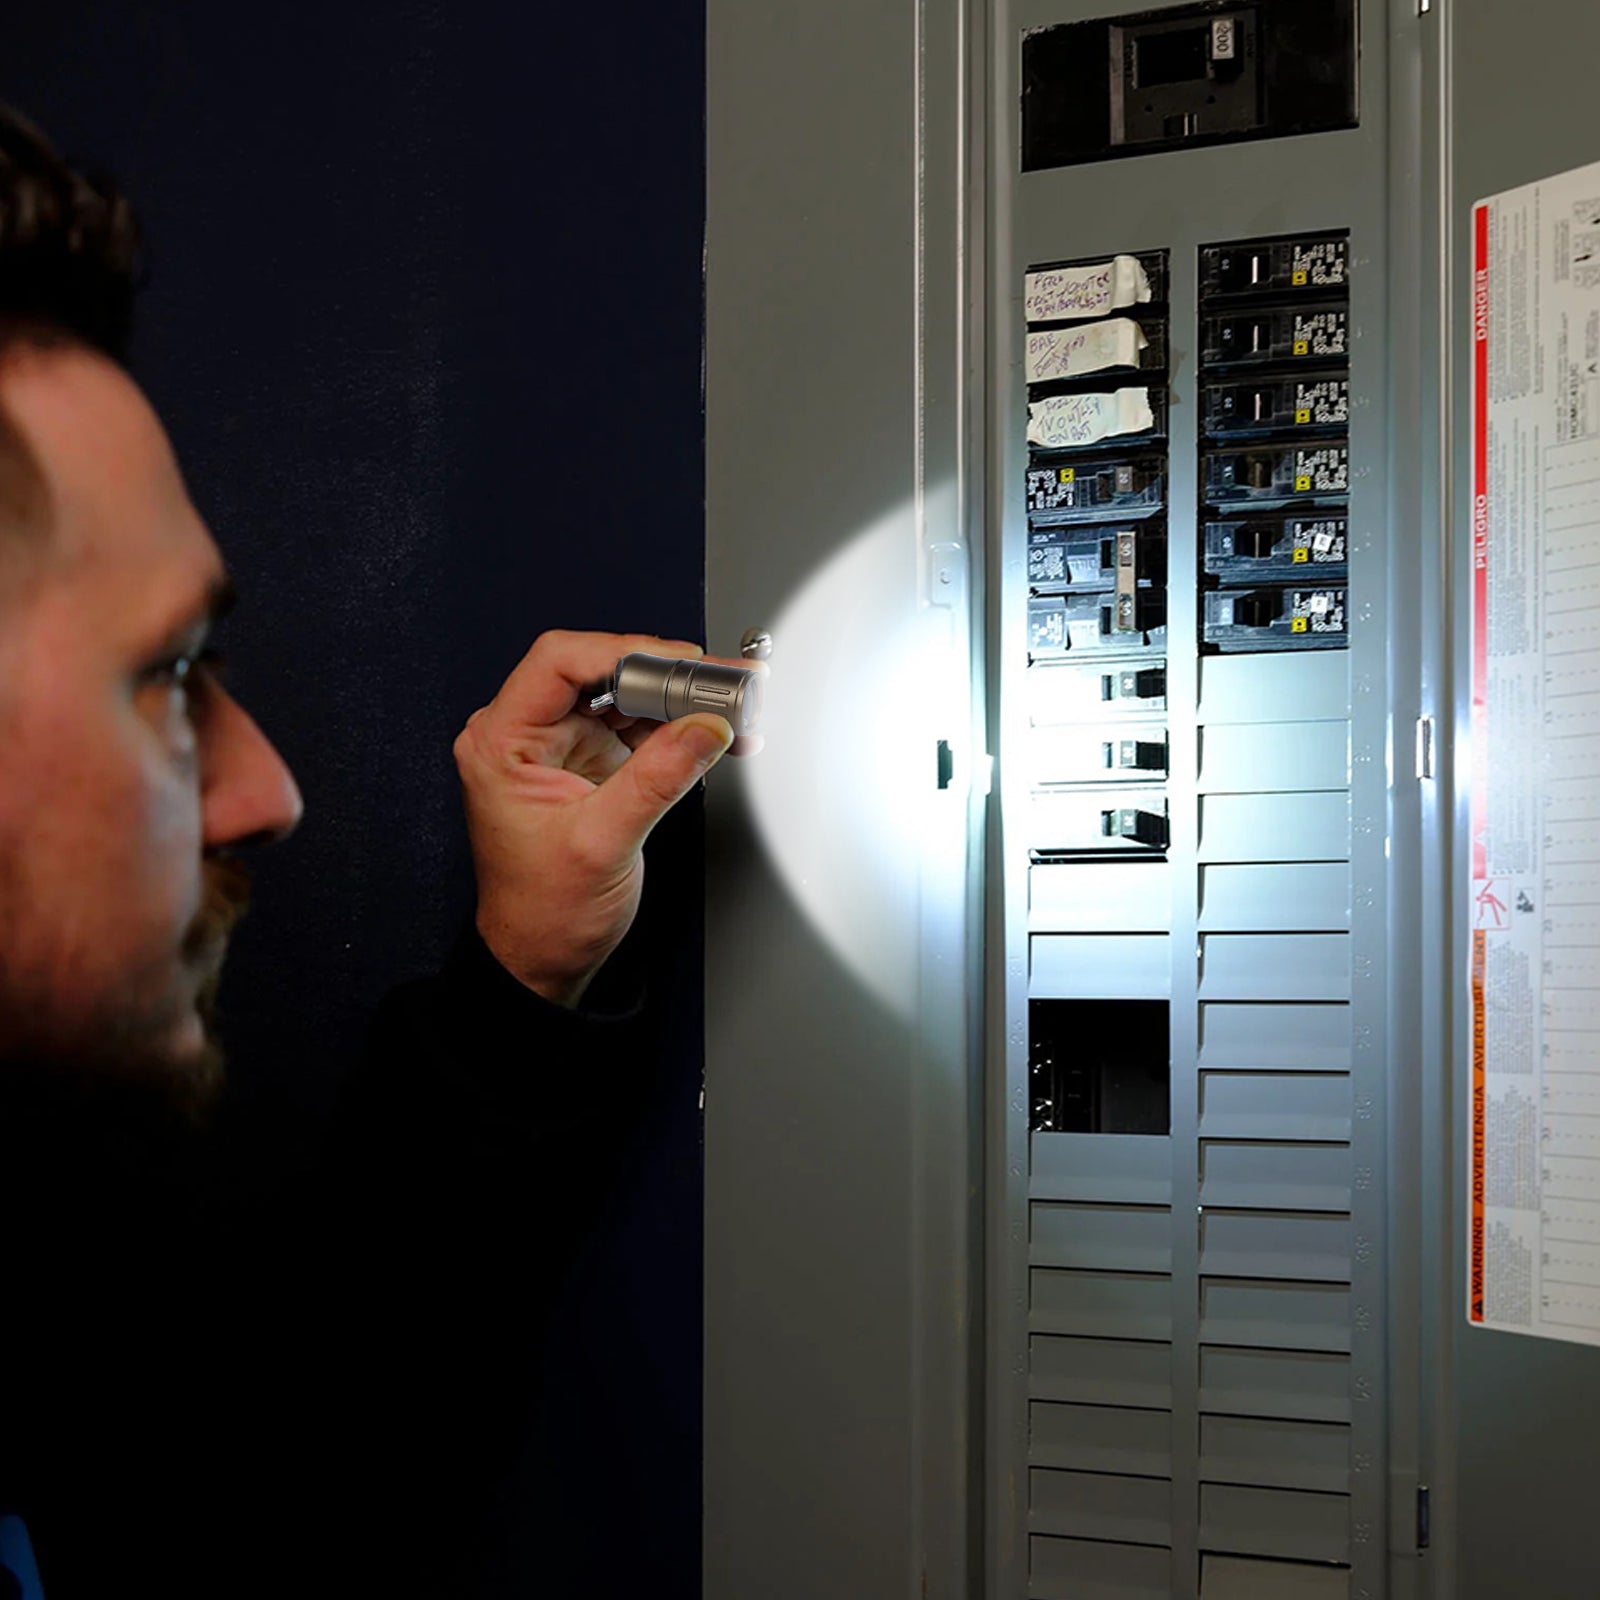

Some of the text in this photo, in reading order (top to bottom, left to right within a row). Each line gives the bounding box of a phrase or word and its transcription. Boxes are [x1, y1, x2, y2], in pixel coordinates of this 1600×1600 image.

[1215, 22, 1231, 53] 200
[1475, 267, 1488, 343] DANGER
[1475, 494, 1488, 570] PELIGRO
[1472, 933, 1486, 1072] AVERTISSEMENT
[1472, 1085, 1485, 1205] ADVERTENCIA
[1472, 1216, 1484, 1295] WARNING
